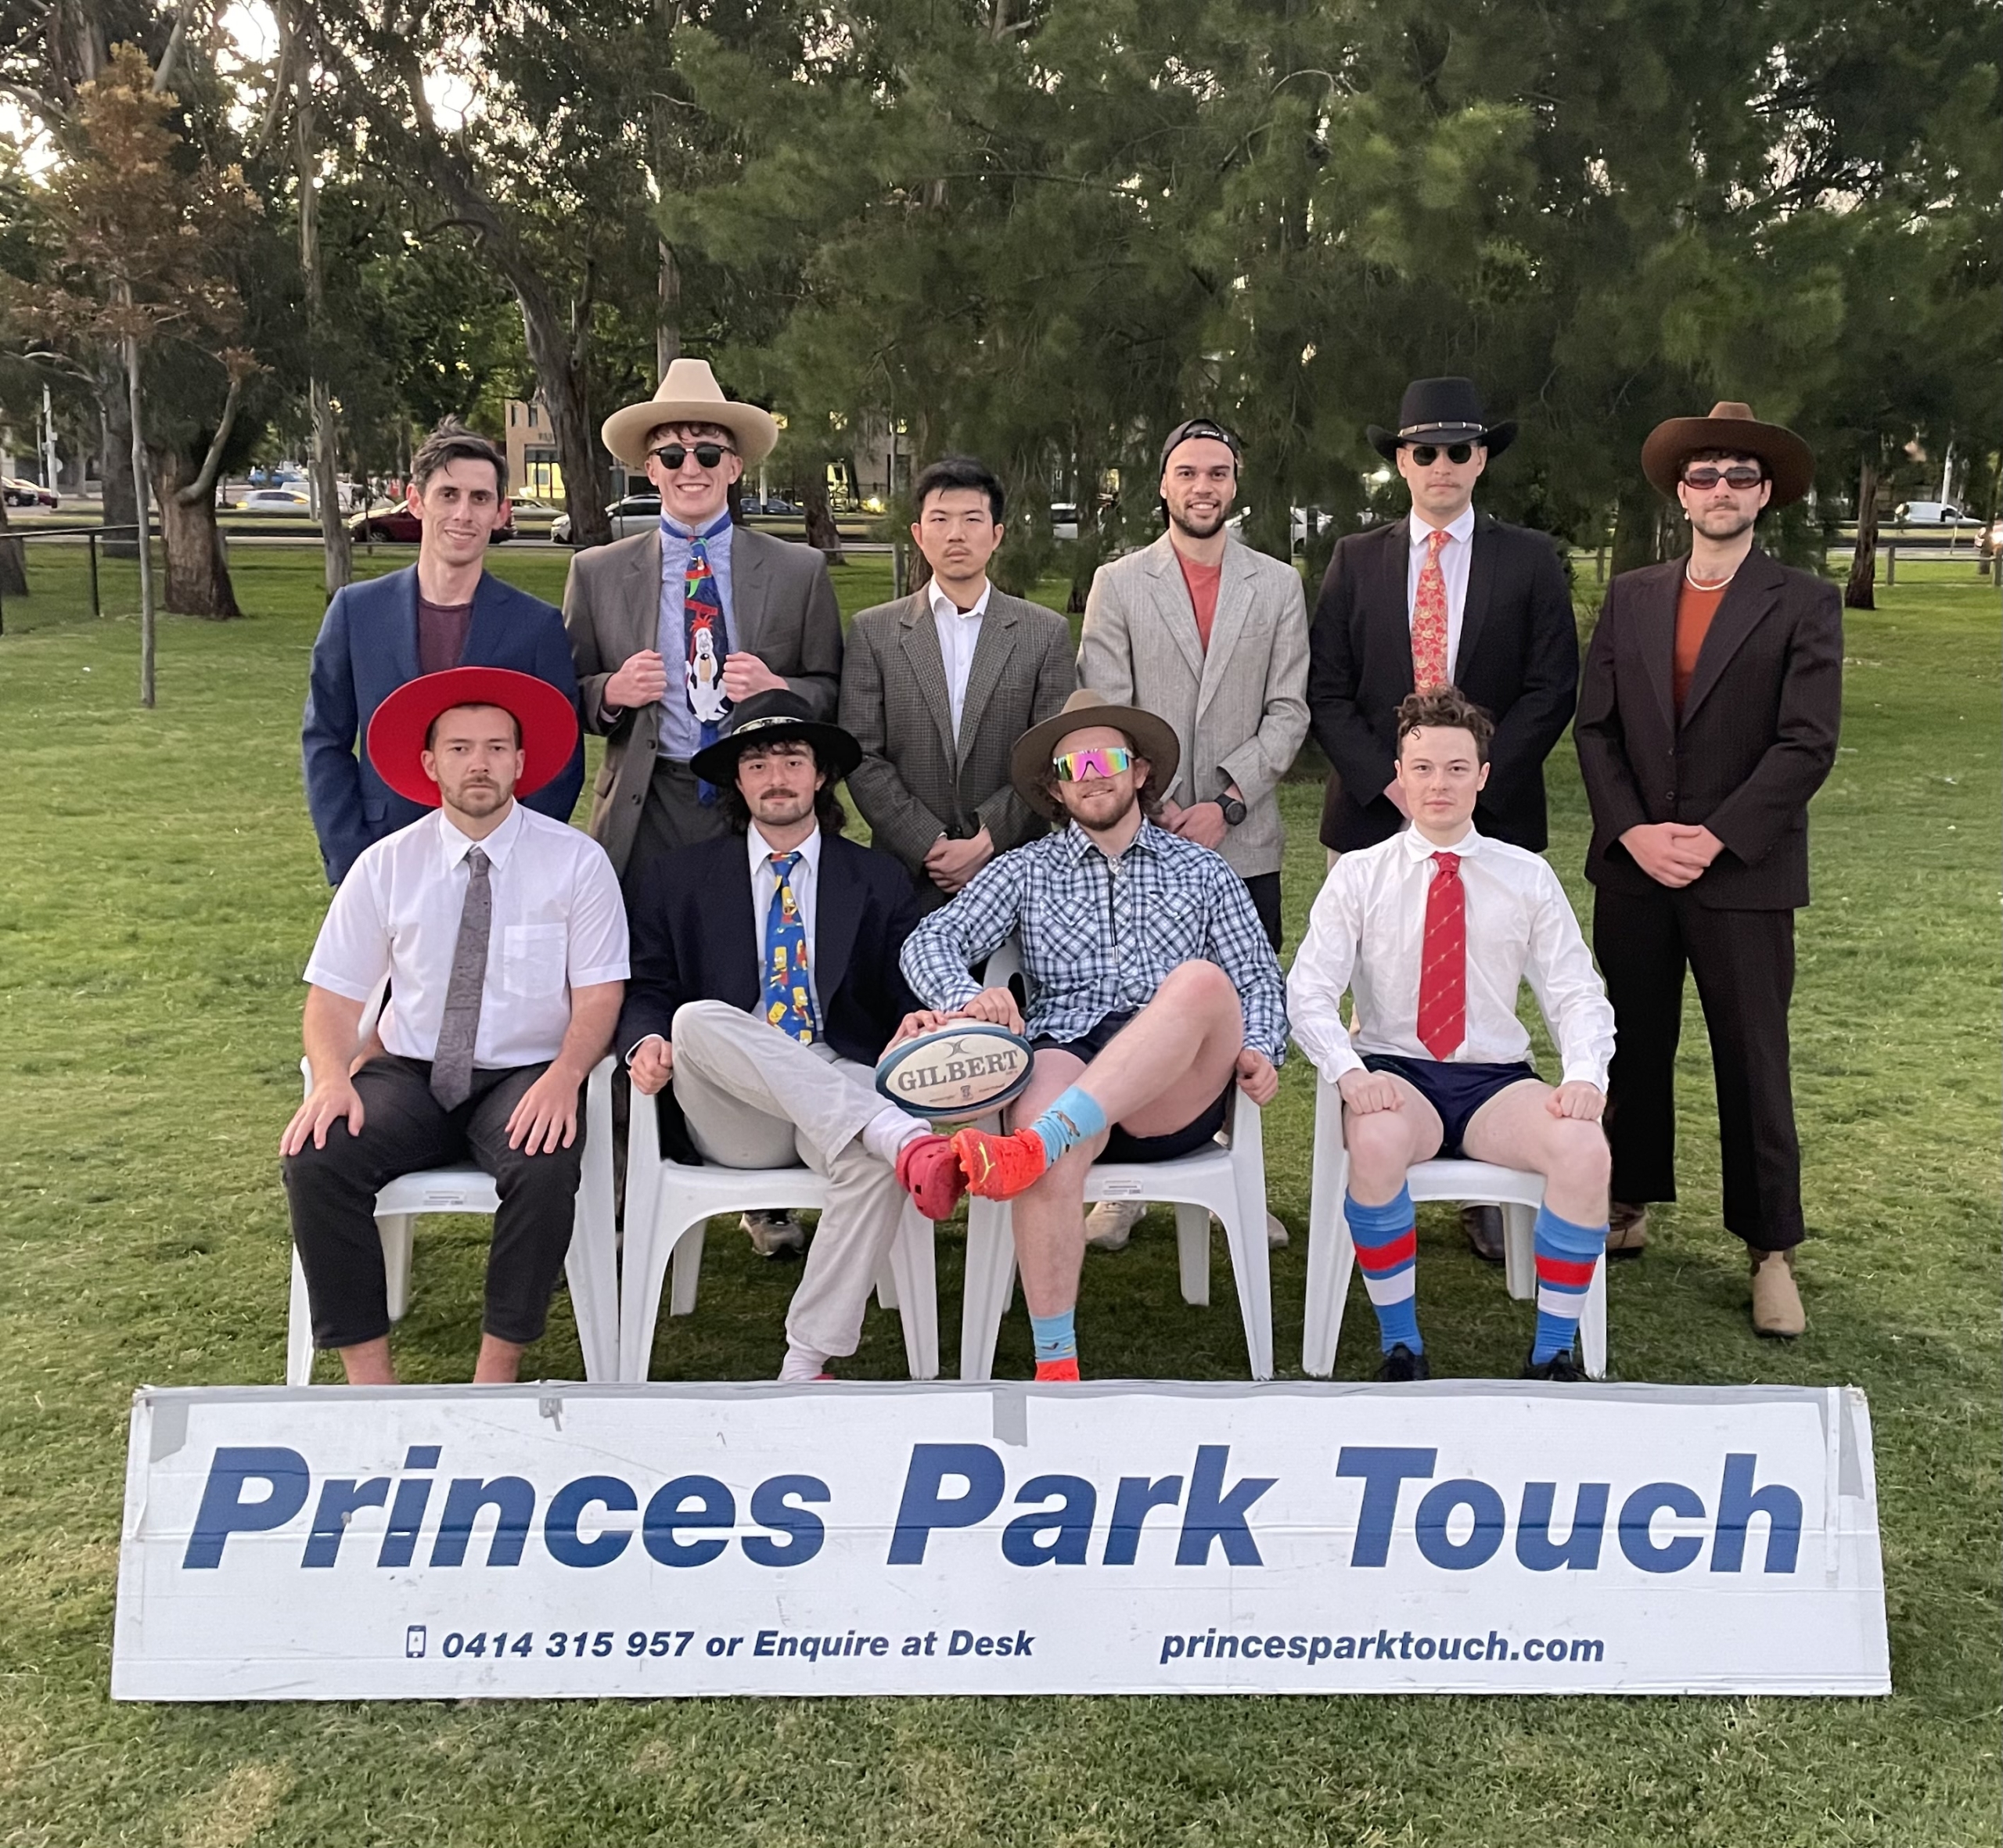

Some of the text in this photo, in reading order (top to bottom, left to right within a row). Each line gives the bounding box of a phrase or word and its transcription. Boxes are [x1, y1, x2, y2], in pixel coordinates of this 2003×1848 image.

[897, 1049, 1018, 1091] GILBERT
[182, 1444, 1802, 1573] Princes Park Touch
[443, 1630, 1035, 1662] 0414 315 957 or Enquire at Desk
[1160, 1630, 1604, 1665] princesparktouch.com
